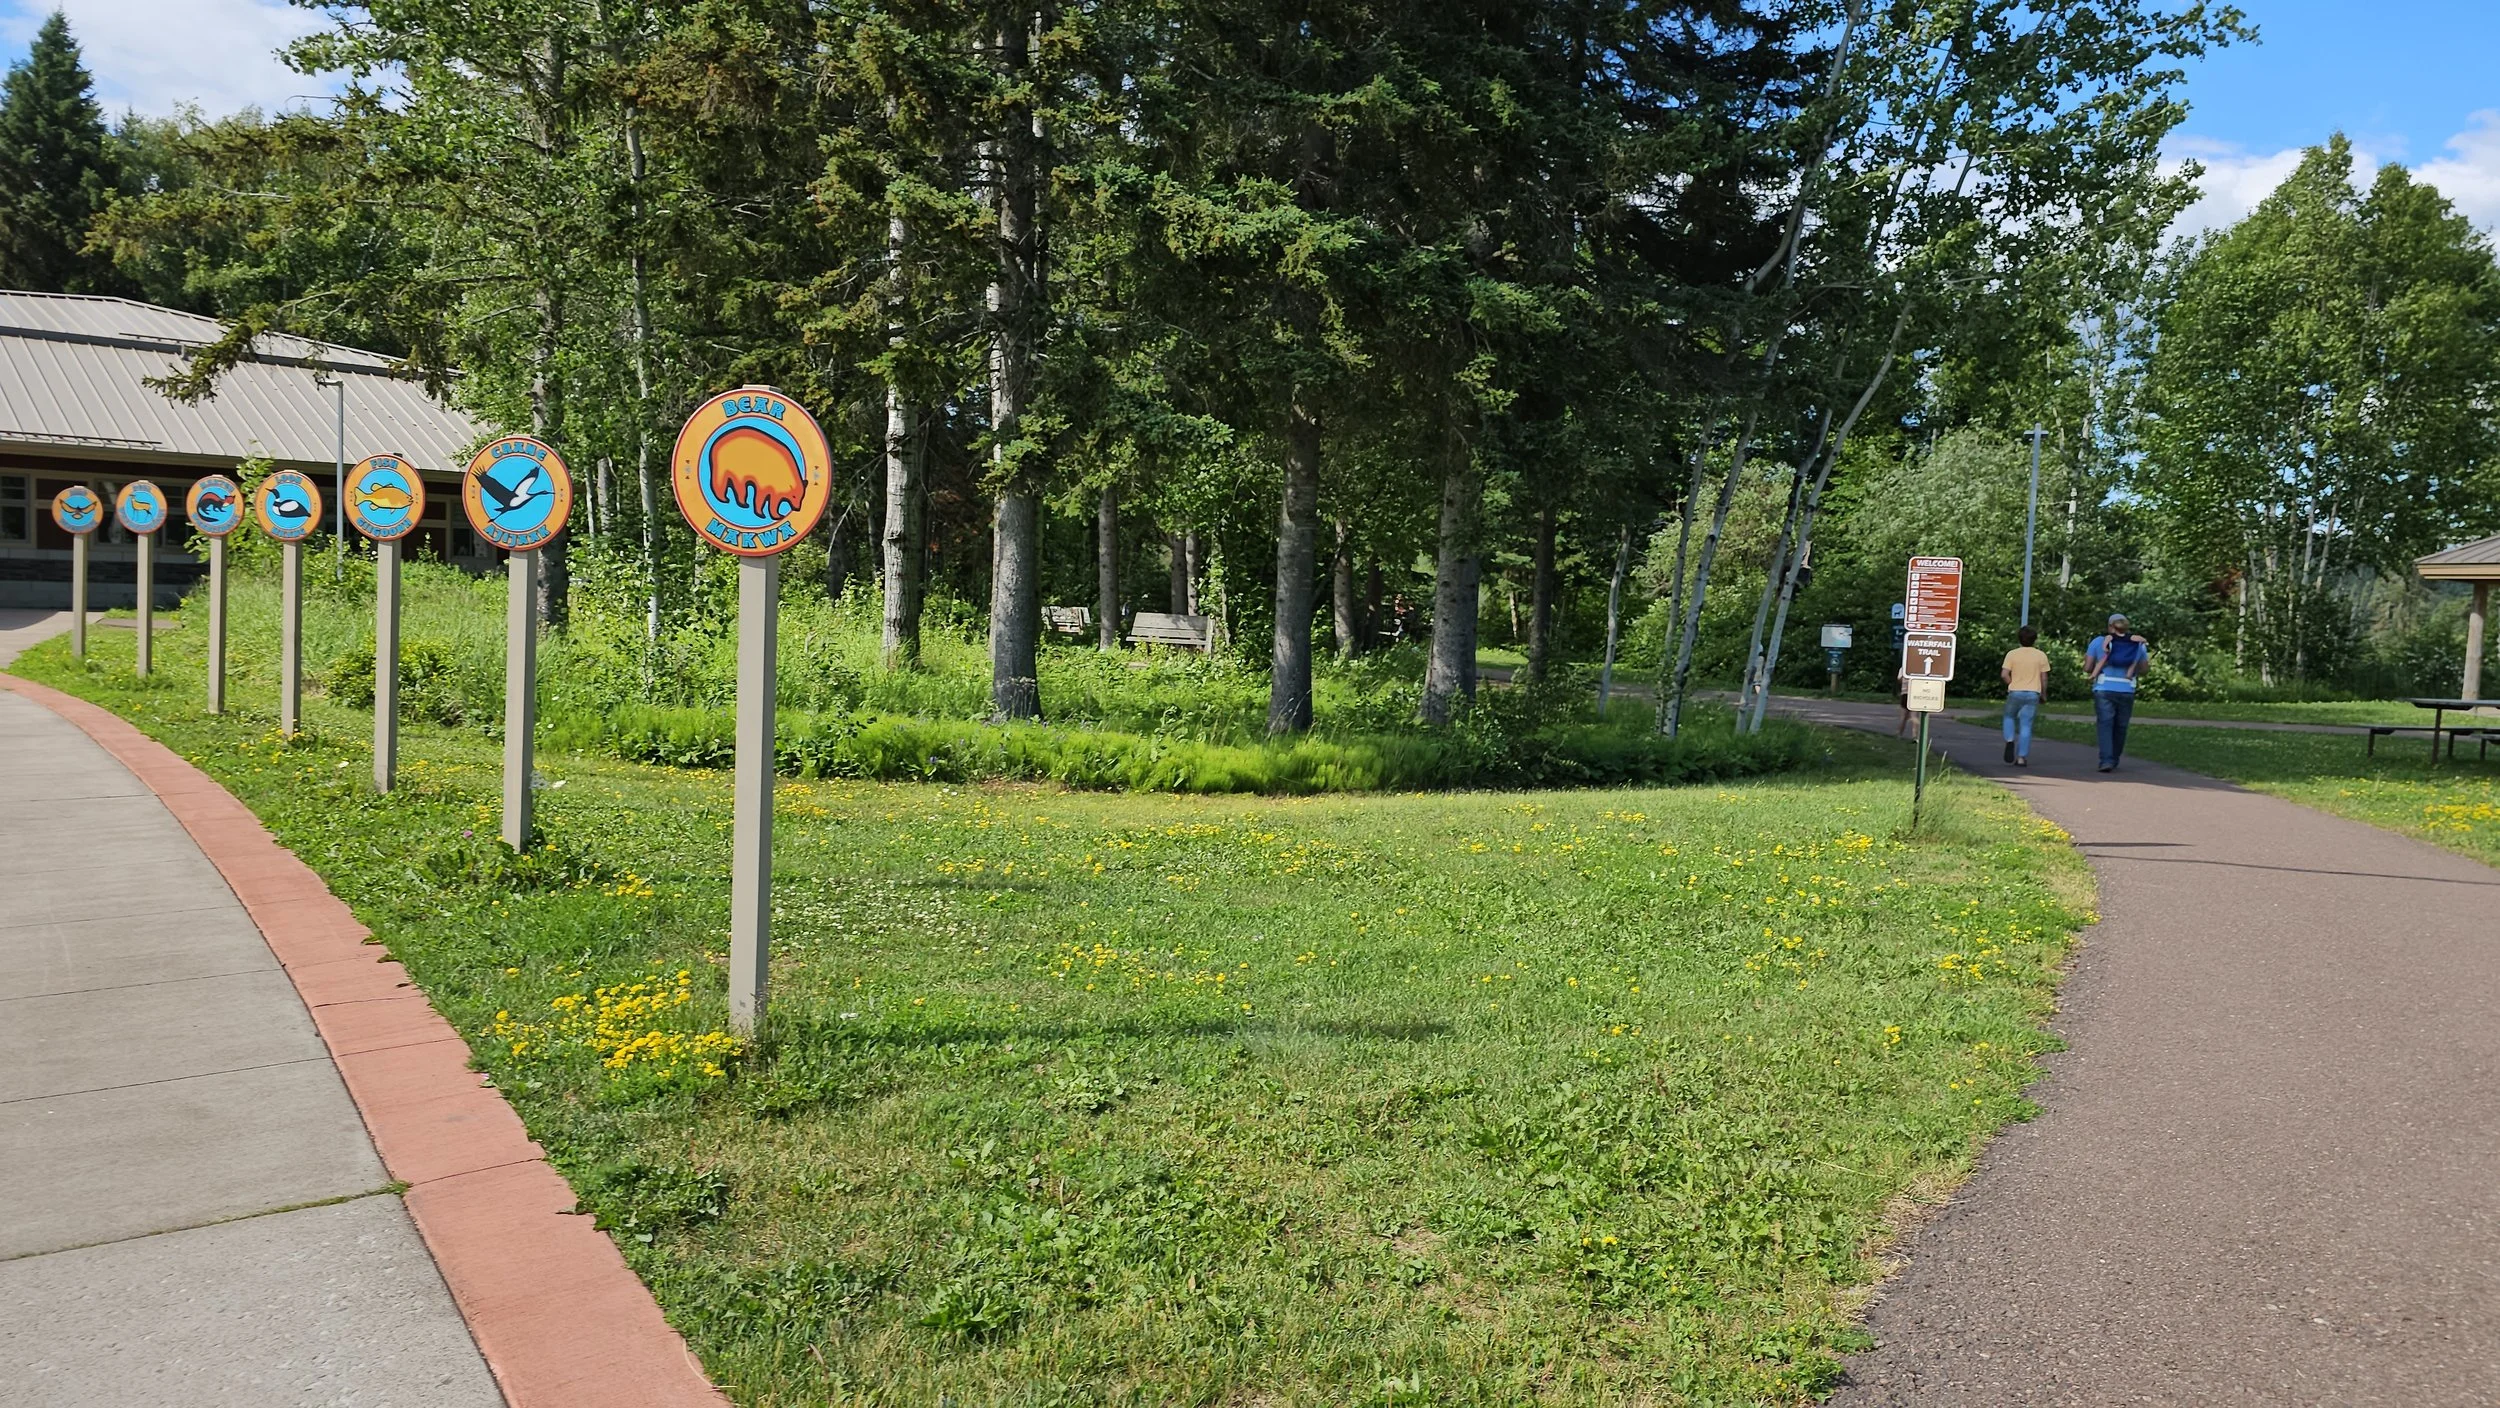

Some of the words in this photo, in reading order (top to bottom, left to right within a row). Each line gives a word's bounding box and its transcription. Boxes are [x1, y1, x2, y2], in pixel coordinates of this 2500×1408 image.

[721, 396, 786, 420] BEAR
[490, 441, 548, 462] CRANE
[369, 458, 399, 469] FISH
[274, 474, 303, 484] LOON
[483, 523, 551, 548] AJIJAAK
[705, 517, 797, 549] MAKWA
[1916, 559, 1958, 568] WELCOME!
[1907, 639, 1952, 649] WATERFALL
[1917, 648, 1941, 657] TRAIL
